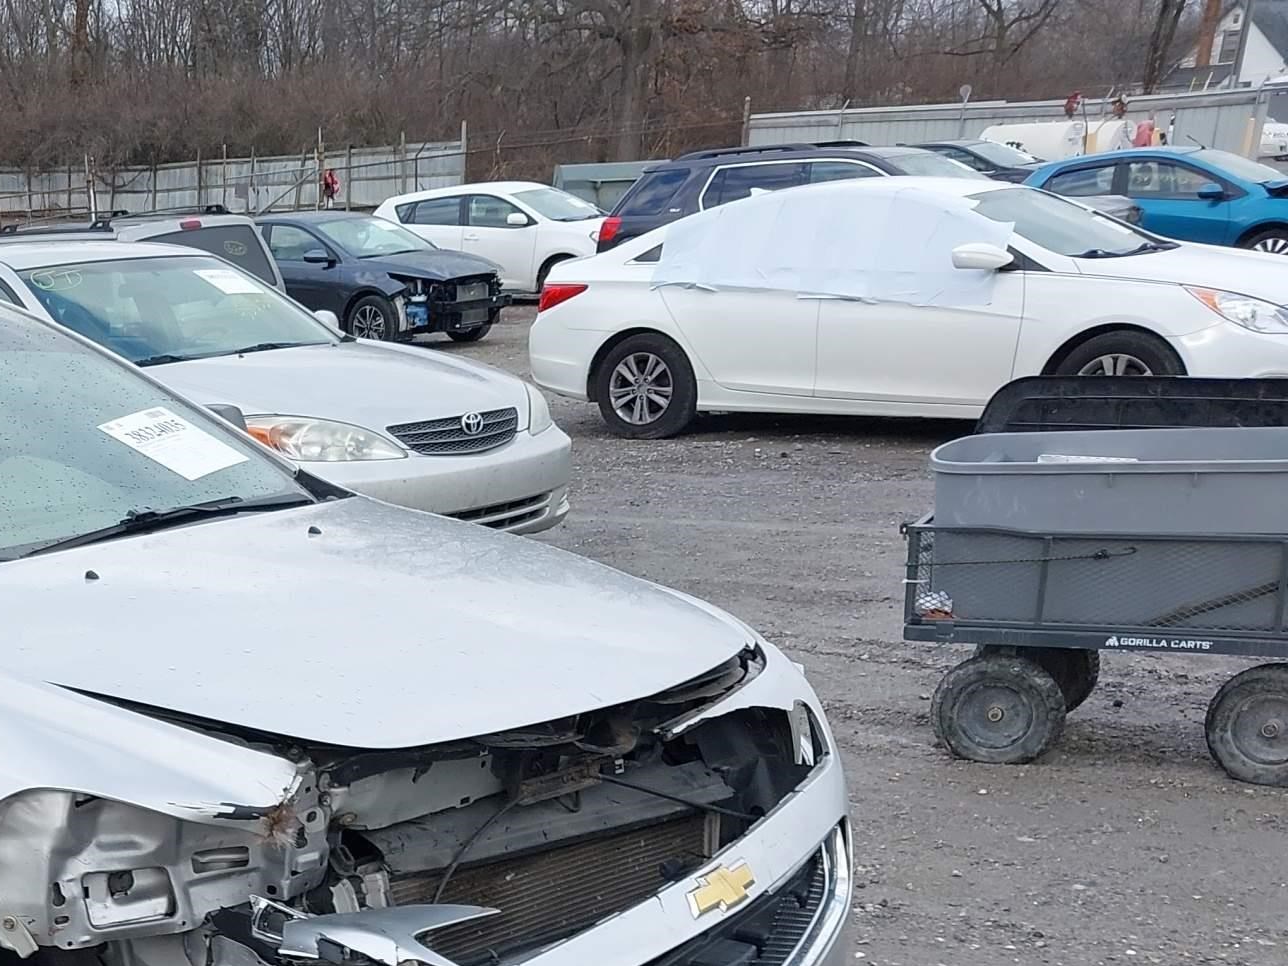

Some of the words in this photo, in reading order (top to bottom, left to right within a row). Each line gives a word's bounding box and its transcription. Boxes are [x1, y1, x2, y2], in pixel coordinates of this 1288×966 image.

[123, 418, 187, 445] 38324035
[1120, 637, 1168, 648] GORILLA
[1170, 640, 1214, 650] CARTS
